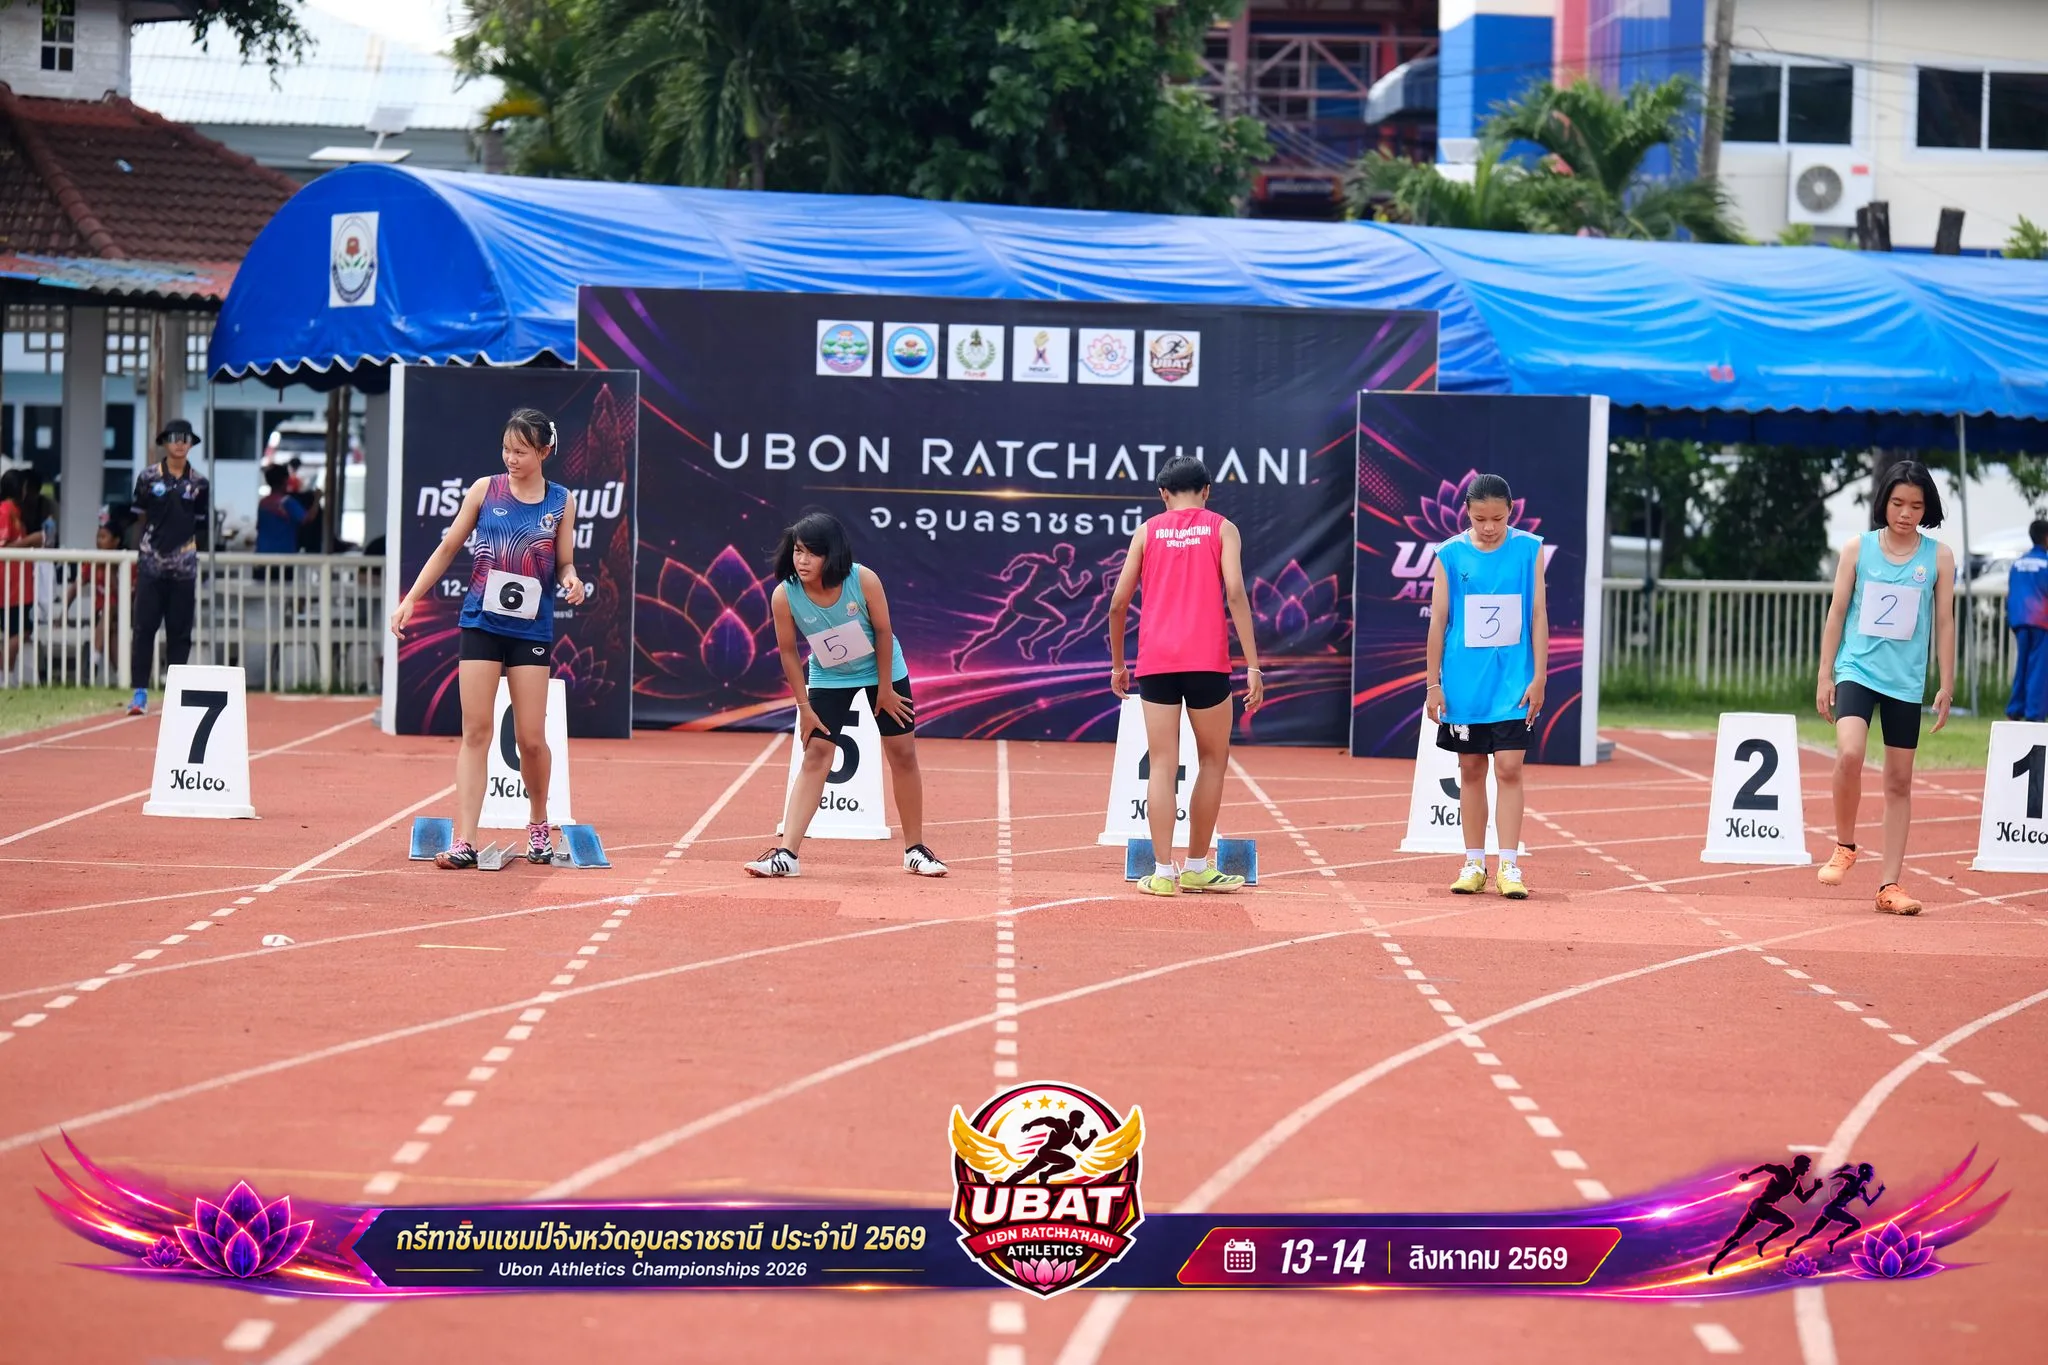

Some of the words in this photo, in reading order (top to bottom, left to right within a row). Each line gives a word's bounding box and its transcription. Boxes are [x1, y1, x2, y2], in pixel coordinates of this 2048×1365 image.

[714, 431, 890, 473] UBON
[922, 437, 1308, 485] RATCHATANI
[499, 581, 525, 610] 6
[1874, 594, 1898, 625] 2
[1479, 606, 1501, 639] 3
[824, 634, 848, 661] 5
[181, 689, 228, 764] 7
[170, 769, 225, 791] Nelco
[1732, 738, 1779, 811] 2
[2012, 744, 2047, 819] 1
[819, 791, 859, 811] elco
[1430, 805, 1461, 826] Nel
[1726, 817, 1779, 839] Nelco
[1996, 821, 2048, 845] Nelco
